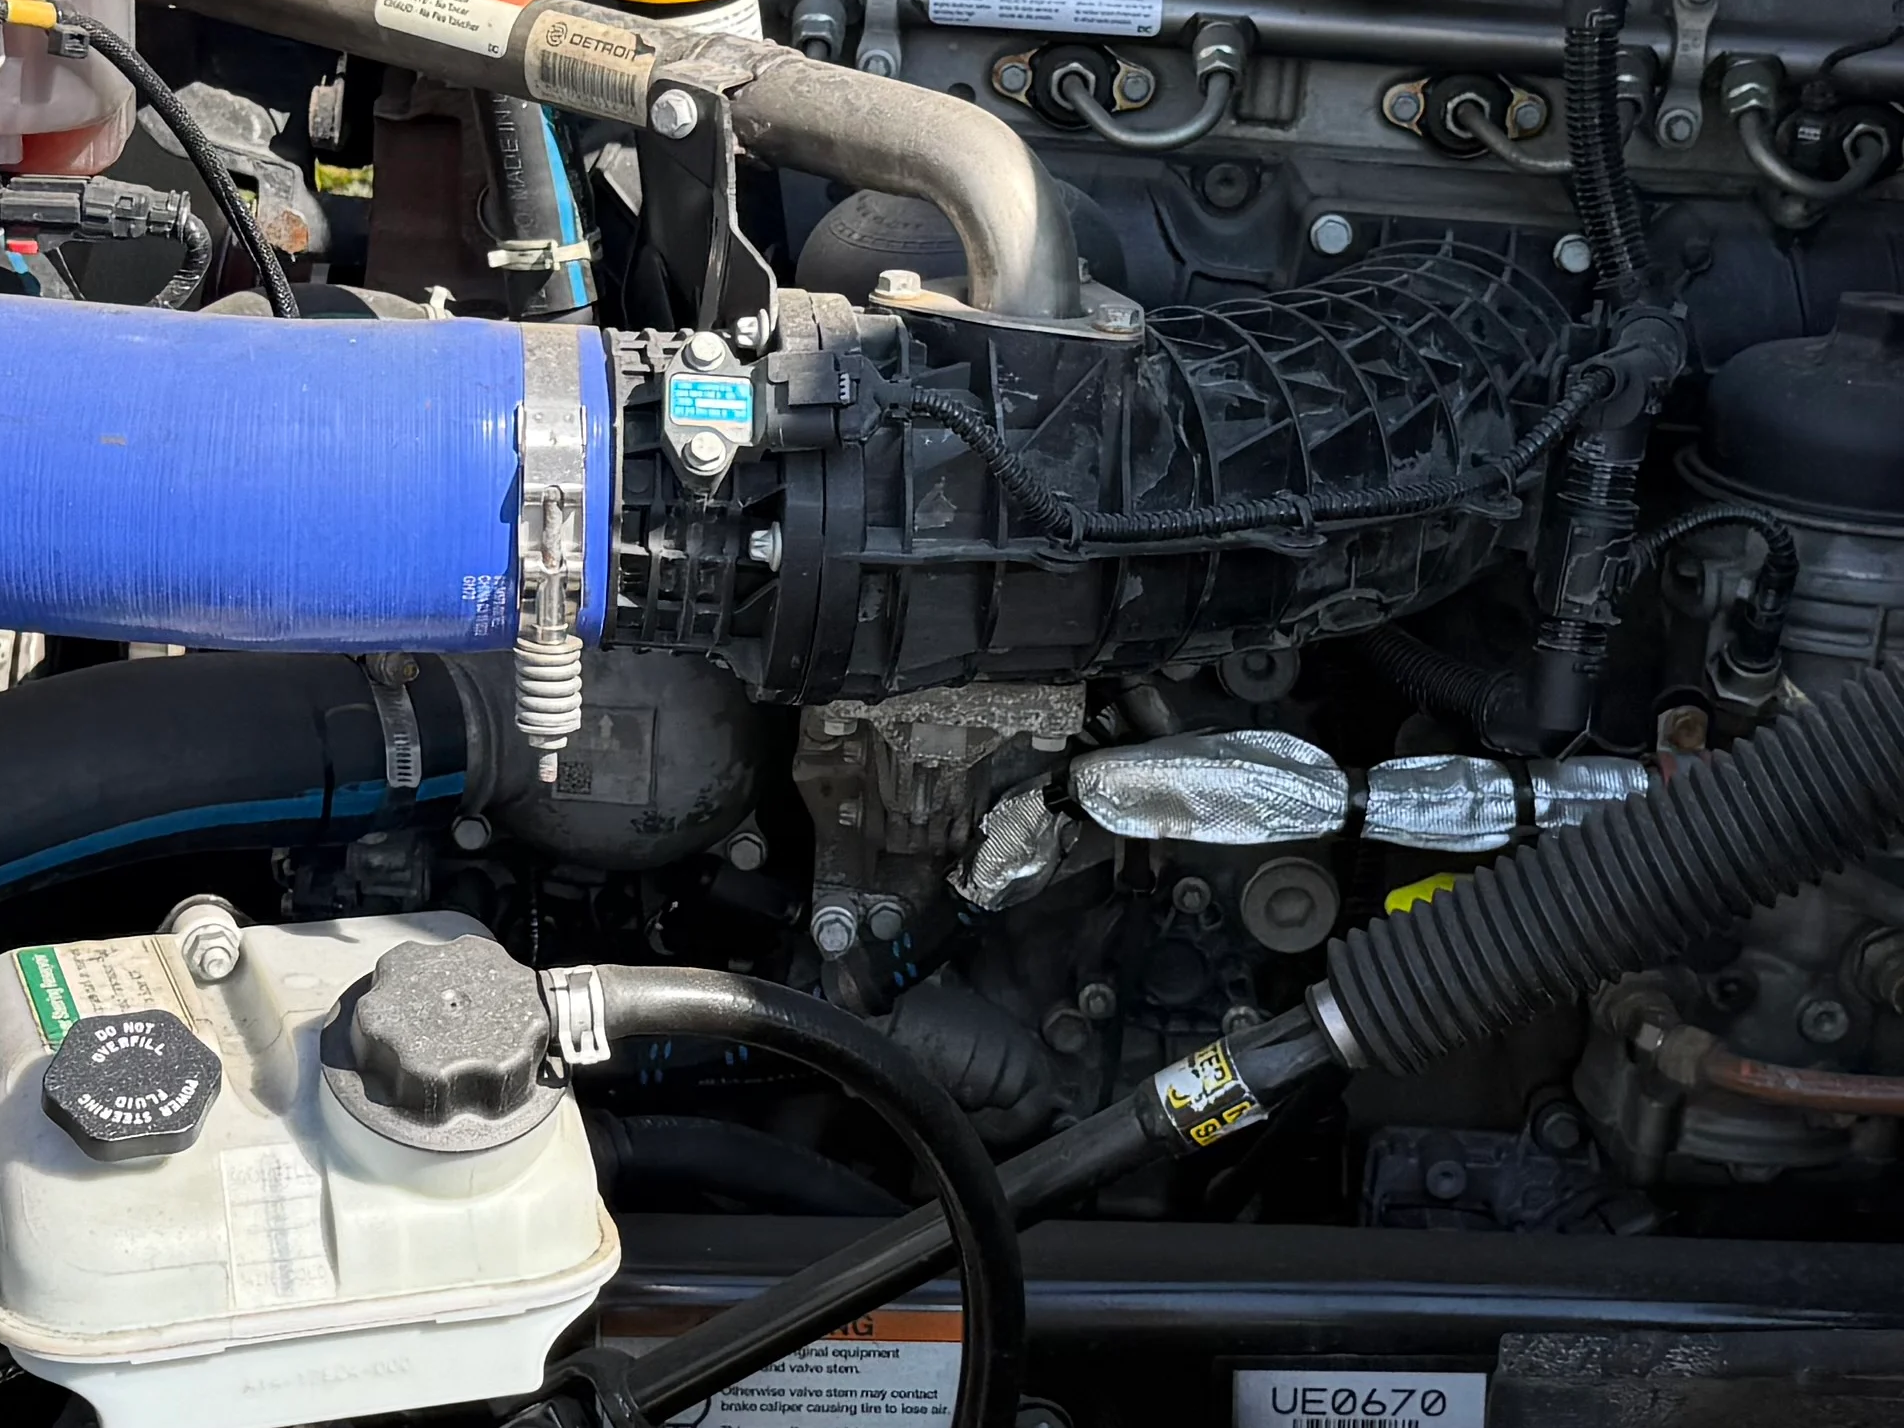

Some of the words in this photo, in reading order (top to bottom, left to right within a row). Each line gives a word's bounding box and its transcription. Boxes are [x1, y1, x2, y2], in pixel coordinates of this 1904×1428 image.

[493, 110, 516, 132] IN
[500, 138, 528, 202] MADE
[94, 1025, 117, 1042] DO
[123, 1021, 155, 1034] NOT
[91, 1035, 165, 1064] OVERFILL
[114, 1088, 169, 1110] FLUID
[158, 1078, 200, 1117] POWER
[77, 1093, 153, 1125] STEERING
[831, 1347, 900, 1360] equipment
[789, 1363, 823, 1374] valve
[826, 1363, 860, 1375] stem.
[721, 1386, 786, 1398] Otherwise
[789, 1387, 823, 1399] valve
[826, 1388, 858, 1399] stem
[860, 1389, 887, 1402] may
[890, 1388, 938, 1400] contact
[1271, 1386, 1447, 1417] UE0670
[721, 1401, 758, 1413] brake
[759, 1401, 803, 1415] caliper
[806, 1402, 858, 1416] causing
[860, 1403, 882, 1415] tire
[884, 1404, 898, 1415] to
[901, 1403, 928, 1415] lose
[931, 1404, 951, 1416] air.
